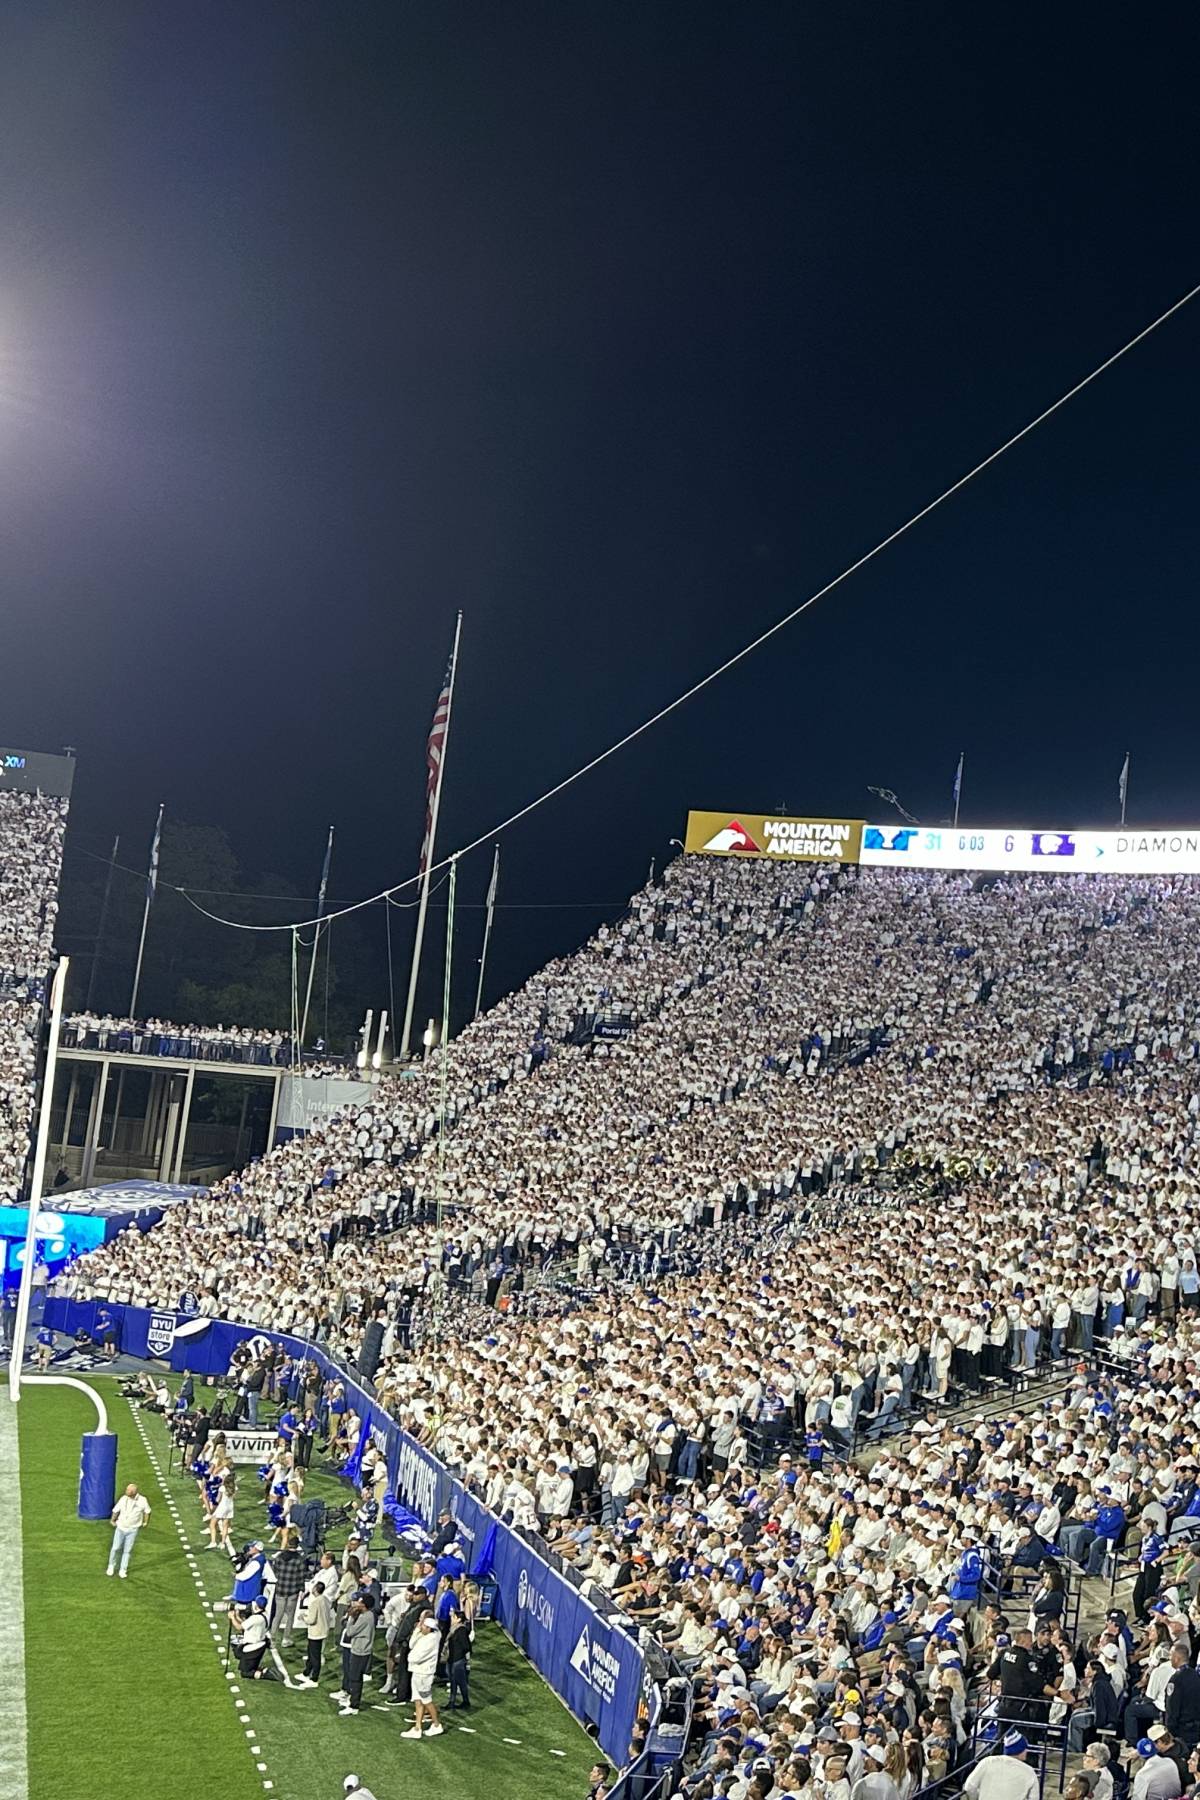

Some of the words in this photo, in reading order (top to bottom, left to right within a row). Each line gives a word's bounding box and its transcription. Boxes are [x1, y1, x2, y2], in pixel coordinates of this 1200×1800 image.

[763, 821, 850, 842] MOUNTAIN
[766, 837, 843, 857] AMERICA
[925, 832, 942, 850] 31
[958, 835, 985, 851] 6:03
[1004, 835, 1015, 852] 6
[152, 1318, 172, 1331] BYU
[150, 1330, 171, 1341] store
[536, 1594, 555, 1633] SKIN
[591, 1640, 621, 1680] MOUNTAIN
[591, 1662, 616, 1697] AMERICA
